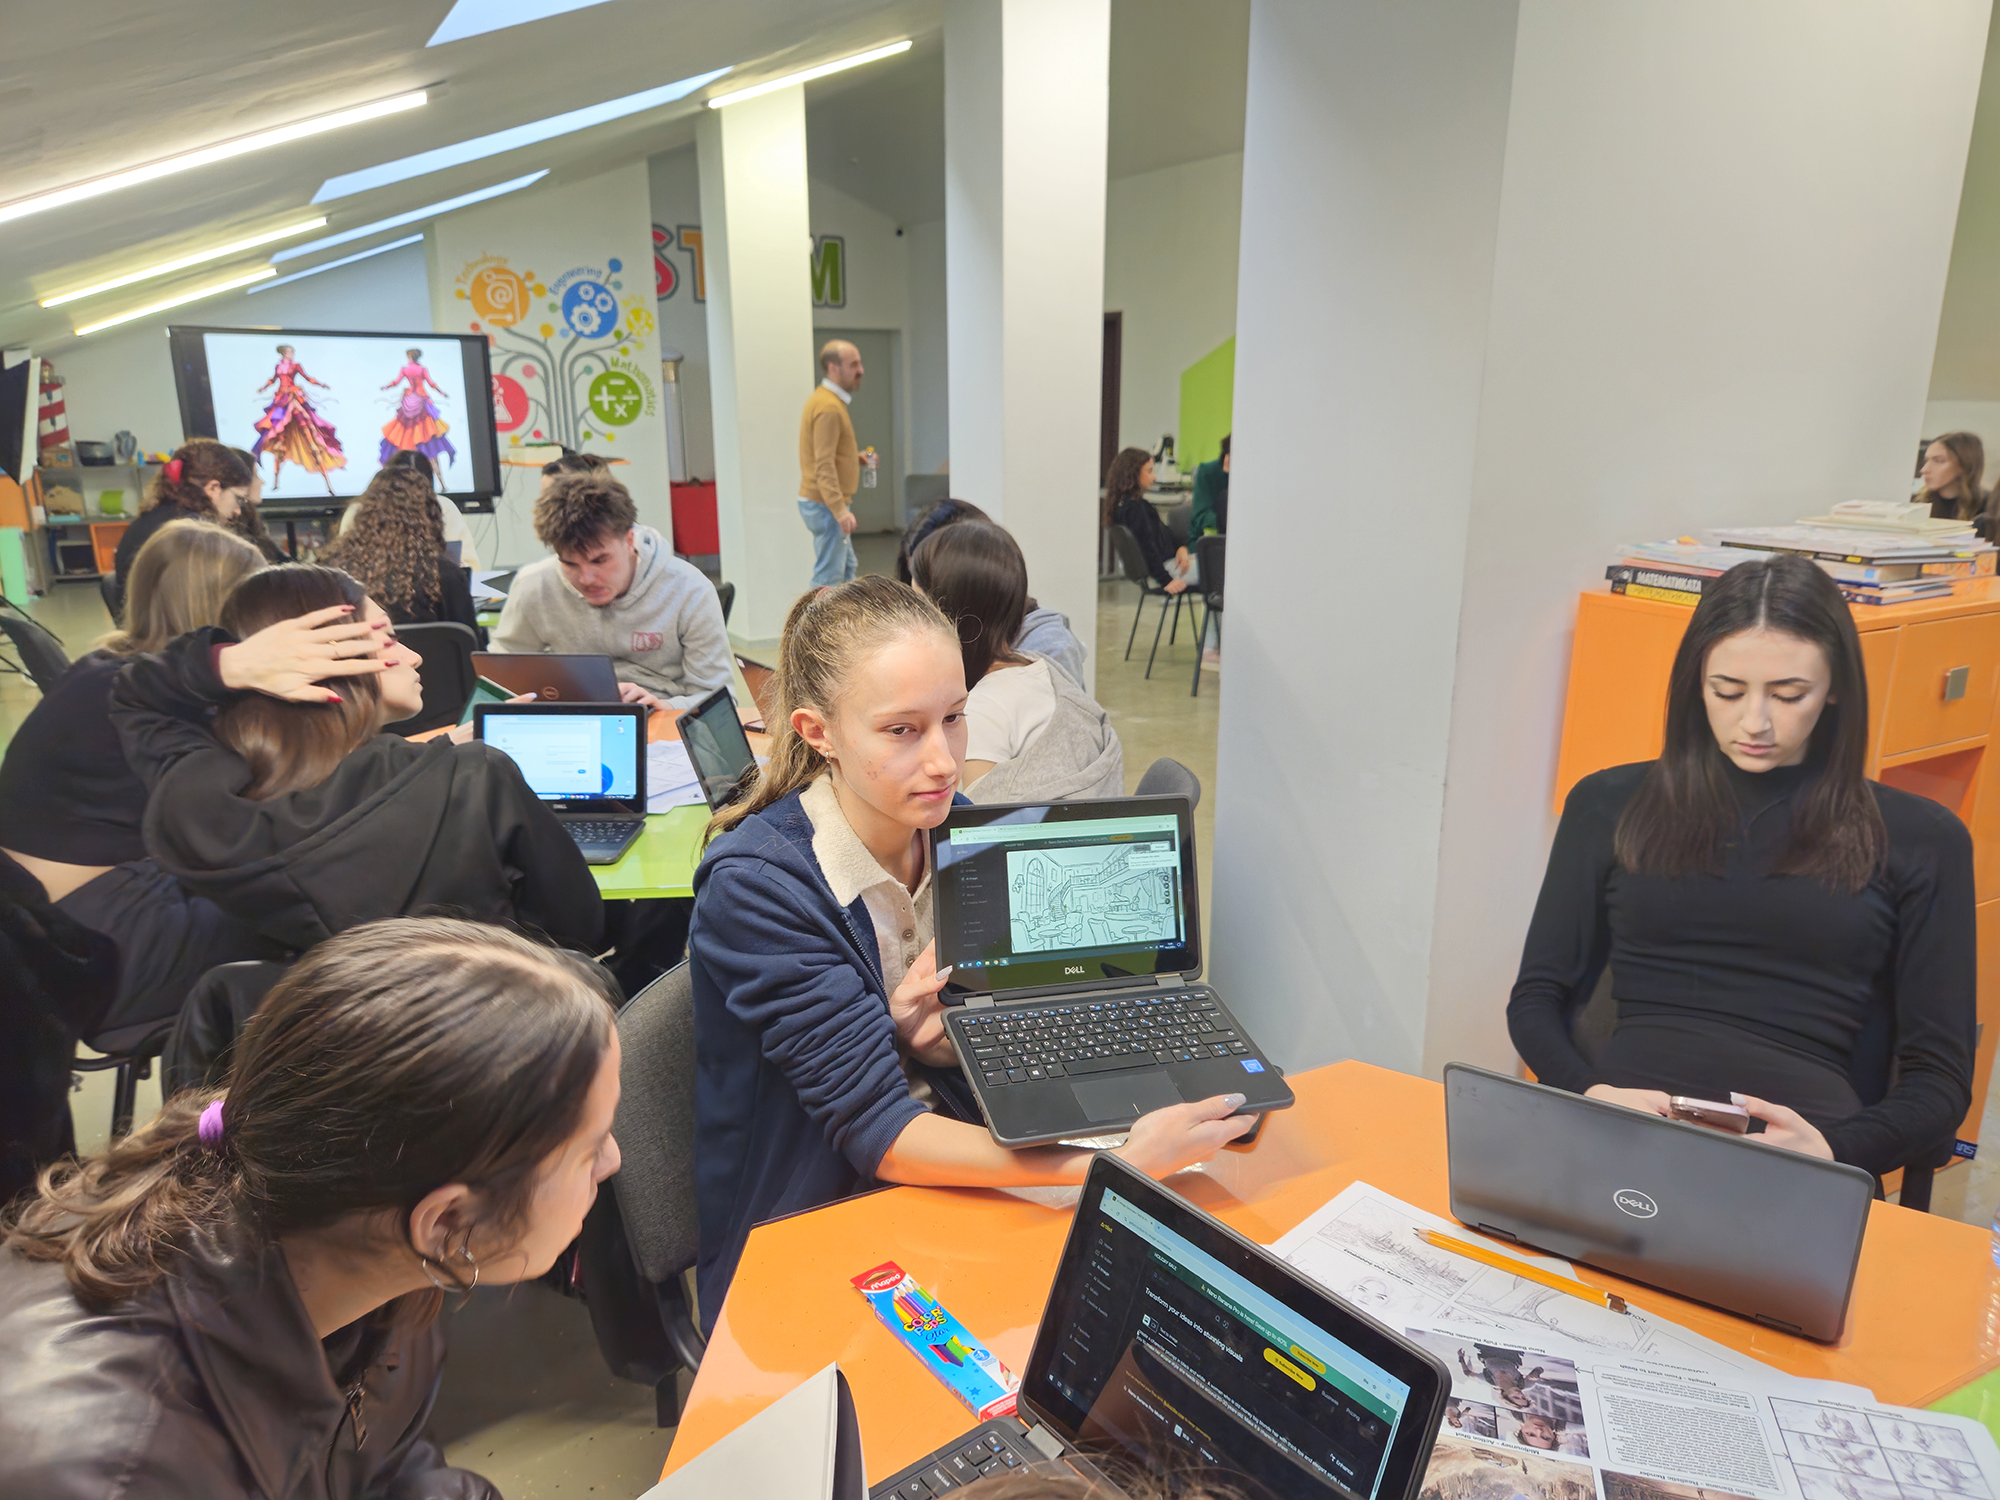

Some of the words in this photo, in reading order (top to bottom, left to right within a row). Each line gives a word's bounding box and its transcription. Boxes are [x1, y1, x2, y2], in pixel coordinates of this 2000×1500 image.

[1619, 1195, 1653, 1212] DELL
[1343, 1247, 1373, 1265] Establishing
[1168, 1262, 1176, 1271] SALE
[870, 1273, 900, 1290] Maped
[1206, 1288, 1217, 1298] Nano
[1217, 1295, 1232, 1309] Banana
[1232, 1305, 1240, 1314] Pro
[1244, 1313, 1254, 1324] here!
[1254, 1321, 1264, 1331] Save
[1264, 1328, 1271, 1337] up
[1276, 1336, 1287, 1347] 40%
[1145, 1287, 1168, 1308] Transform
[1168, 1304, 1179, 1317] your
[1179, 1312, 1192, 1326] ideas
[1193, 1322, 1203, 1333] into
[1203, 1329, 1225, 1350] stunning
[1225, 1345, 1243, 1362] visuals
[925, 1328, 949, 1343] Star
[1455, 1332, 1480, 1342] Realistic
[1503, 1342, 1526, 1350] Banana
[1279, 1360, 1295, 1374] Subscribe
[1687, 1377, 1716, 1386] Prompts
[1322, 1390, 1338, 1405] Business
[1346, 1407, 1360, 1421] Pricing
[1455, 1432, 1470, 1440] Shot
[1472, 1436, 1494, 1445] Action
[1501, 1442, 1539, 1454] Midjourney
[1336, 1460, 1352, 1476] Enhance
[1638, 1471, 1665, 1480] Render
[1667, 1476, 1699, 1486] Realistic
[1705, 1483, 1733, 1492] Banana
